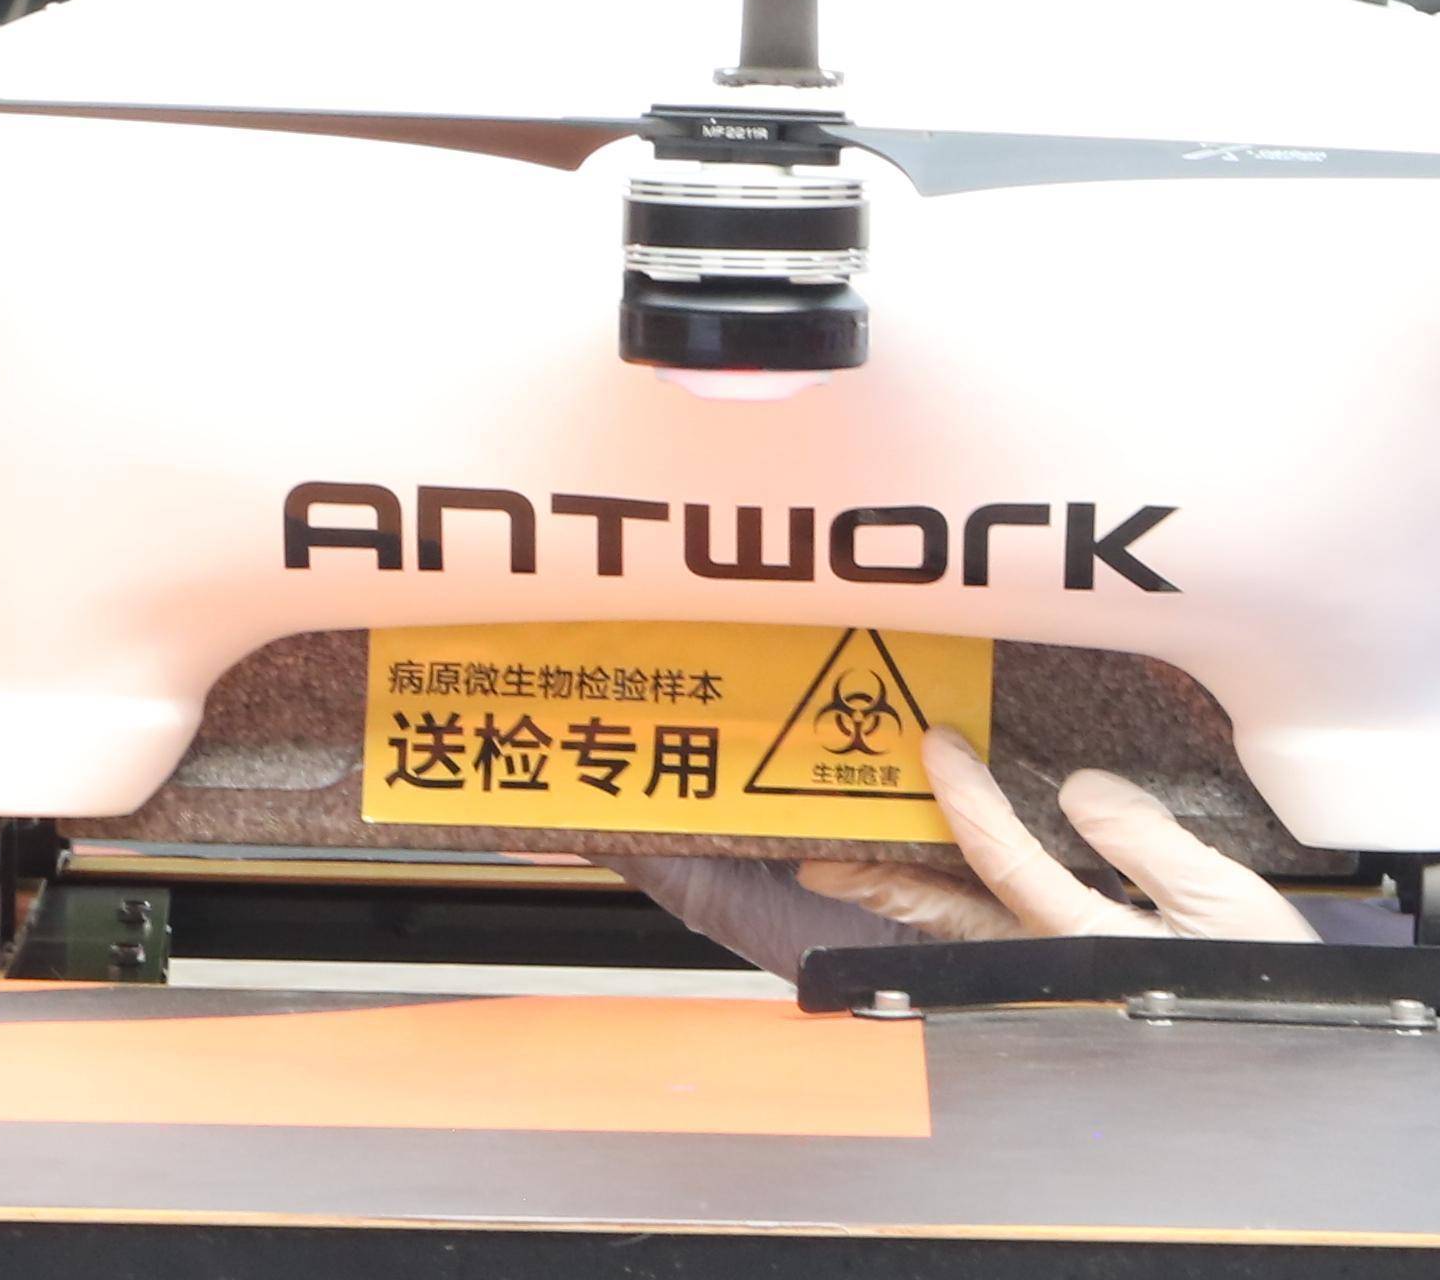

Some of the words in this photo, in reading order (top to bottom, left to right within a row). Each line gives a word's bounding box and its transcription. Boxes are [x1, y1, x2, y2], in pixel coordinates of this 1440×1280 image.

[283, 480, 1182, 594] ANTWORK
[388, 659, 723, 705] 病原微生物检验样本
[384, 711, 720, 800] 送检专用
[811, 762, 901, 787] 生物危害
